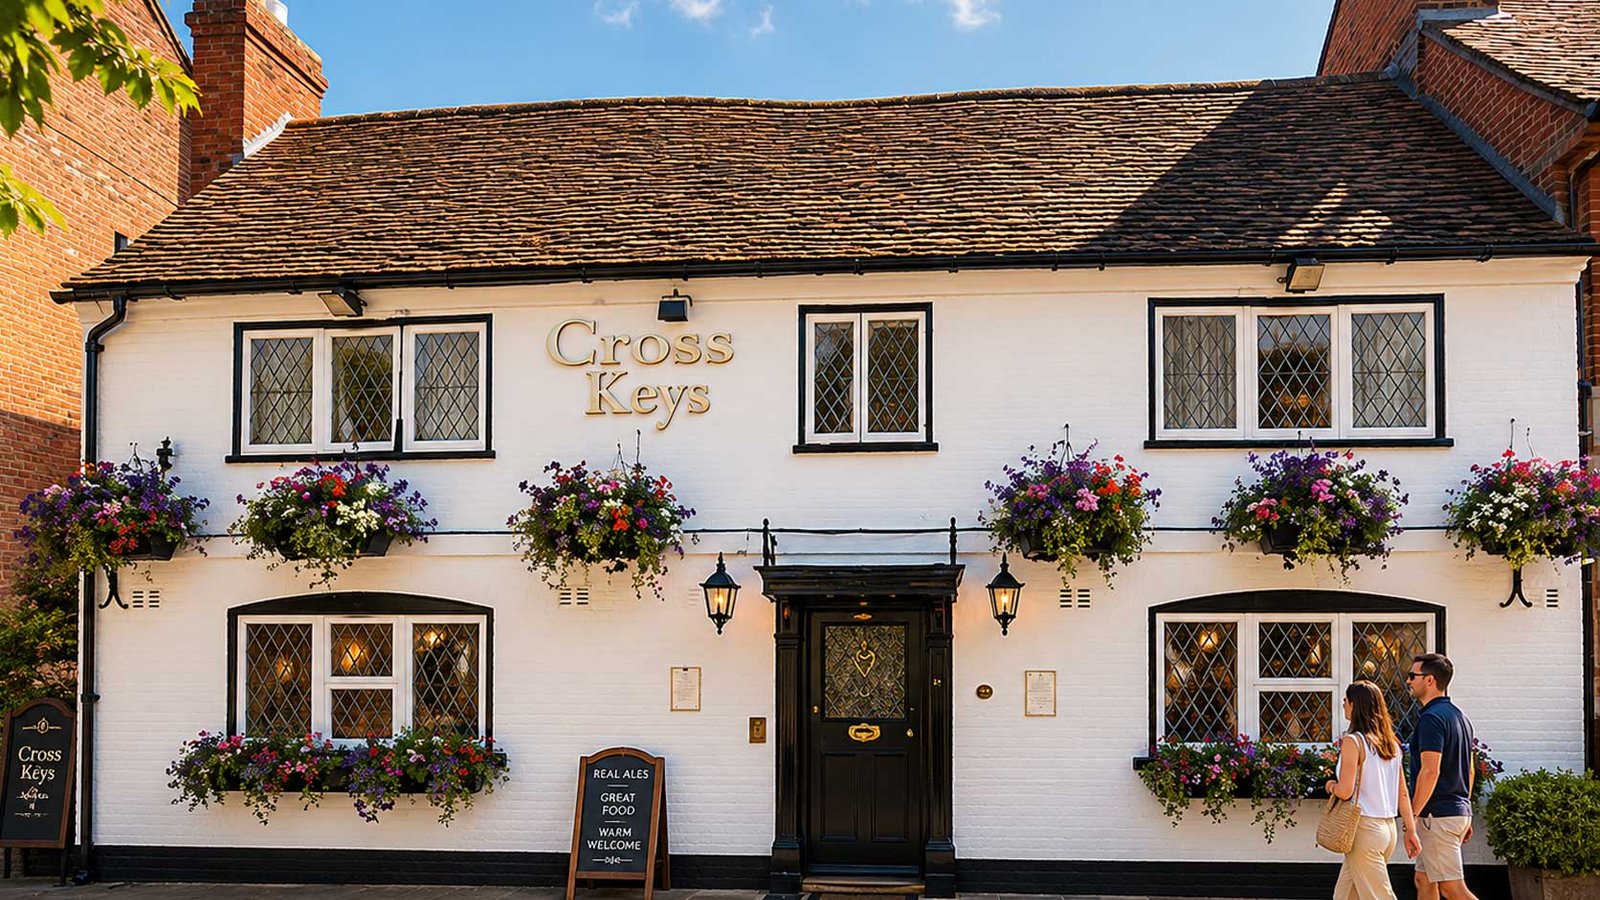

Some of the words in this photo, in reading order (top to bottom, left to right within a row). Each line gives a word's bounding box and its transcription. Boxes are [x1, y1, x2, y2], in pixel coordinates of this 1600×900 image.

[546, 318, 735, 367] Cross
[585, 371, 711, 431] Keys
[18, 746, 62, 762] Cross
[20, 764, 55, 785] Keys
[593, 769, 620, 779] REAL
[622, 769, 649, 779] ALES
[600, 793, 636, 803] GREAT
[602, 805, 635, 815] FOOD
[598, 827, 632, 837] WARM
[587, 840, 641, 850] WELCOME
